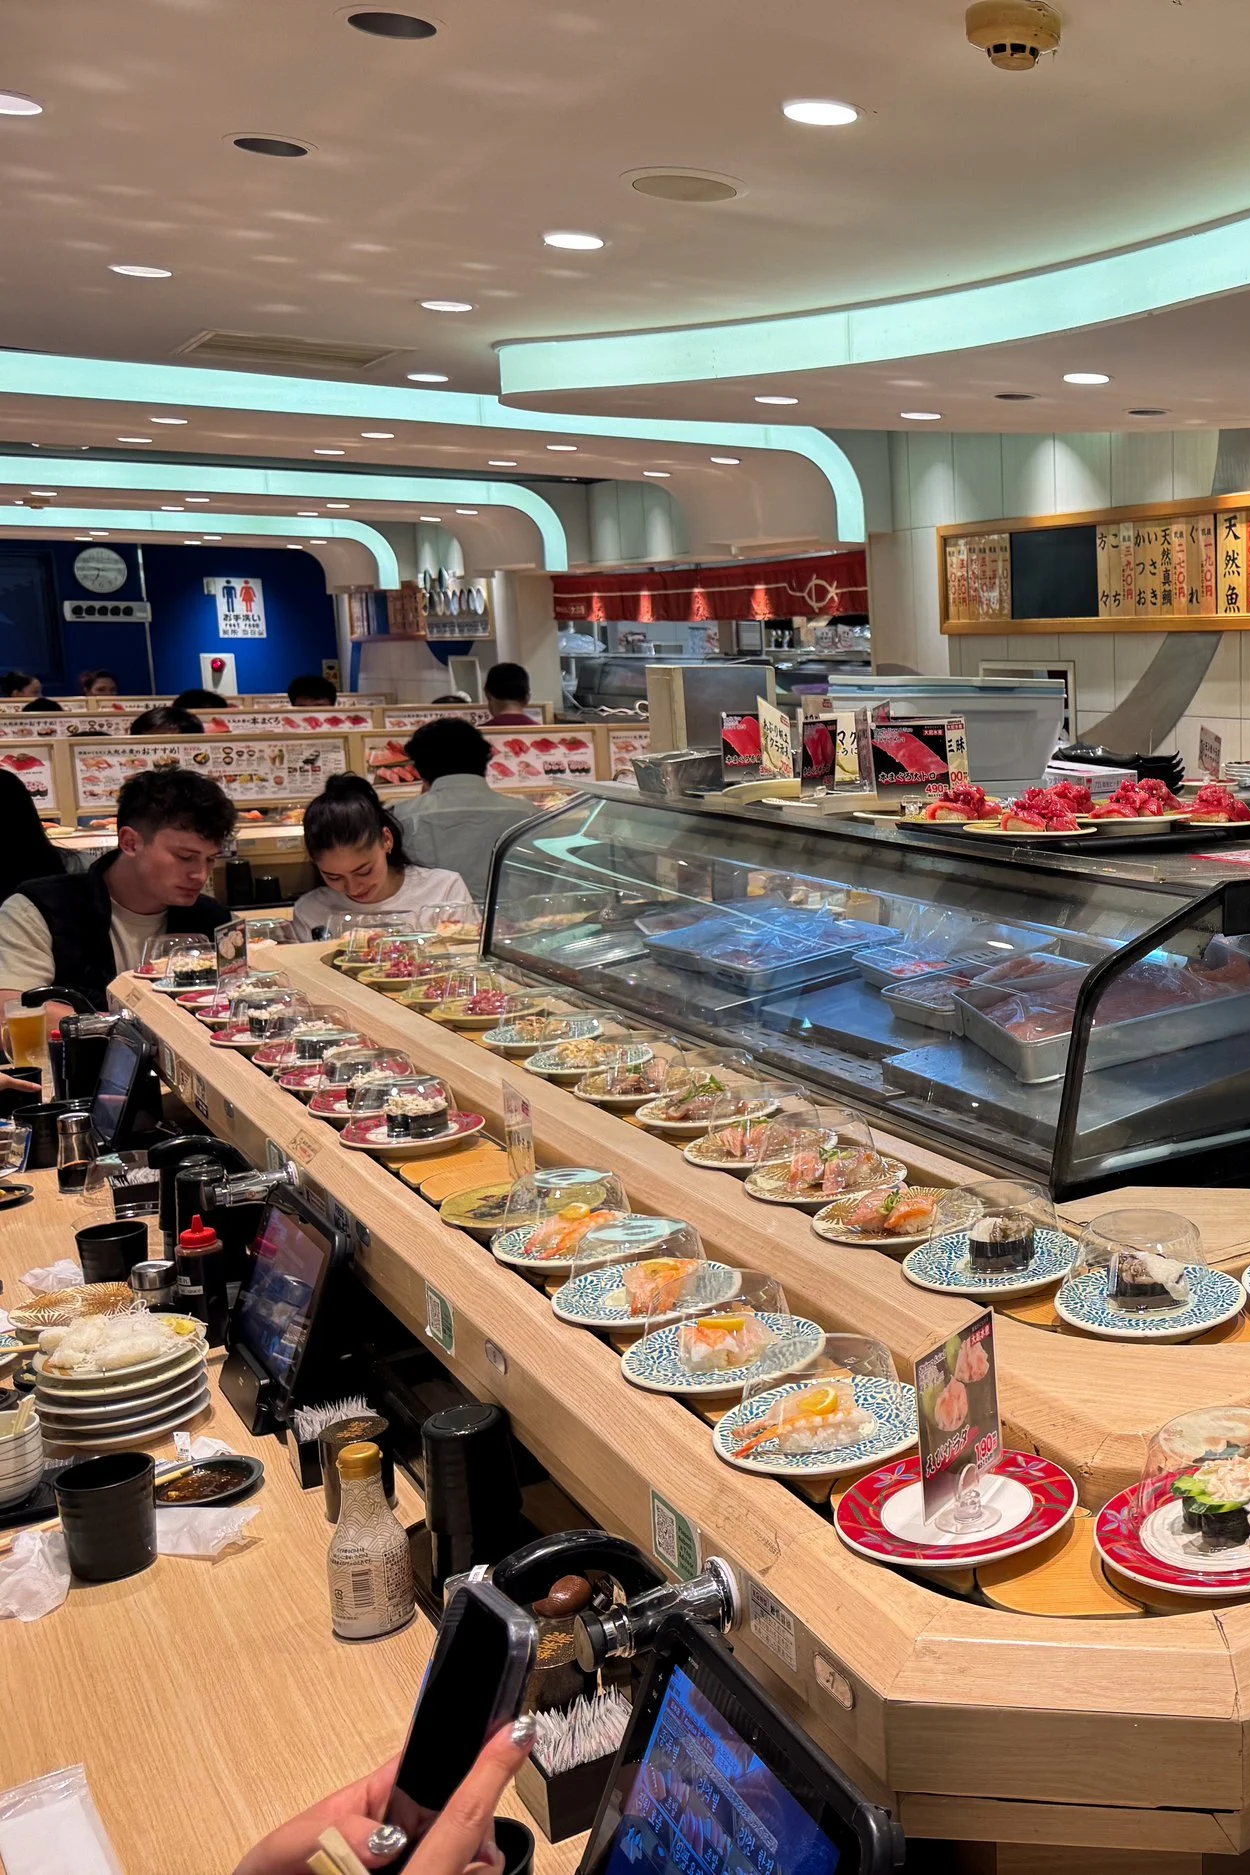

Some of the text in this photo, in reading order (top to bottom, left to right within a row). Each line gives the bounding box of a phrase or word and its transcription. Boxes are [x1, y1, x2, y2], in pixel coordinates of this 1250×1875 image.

[1110, 533, 1121, 607] こち
[1134, 532, 1146, 606] かつお
[1147, 532, 1158, 606] いさき
[1160, 527, 1172, 606] 天然真鯛
[1188, 525, 1200, 604] ぐれ
[1223, 515, 1241, 613] 天然魚
[878, 772, 936, 783] 本まぐろ大トロ
[925, 1424, 970, 1479] えびサラダ
